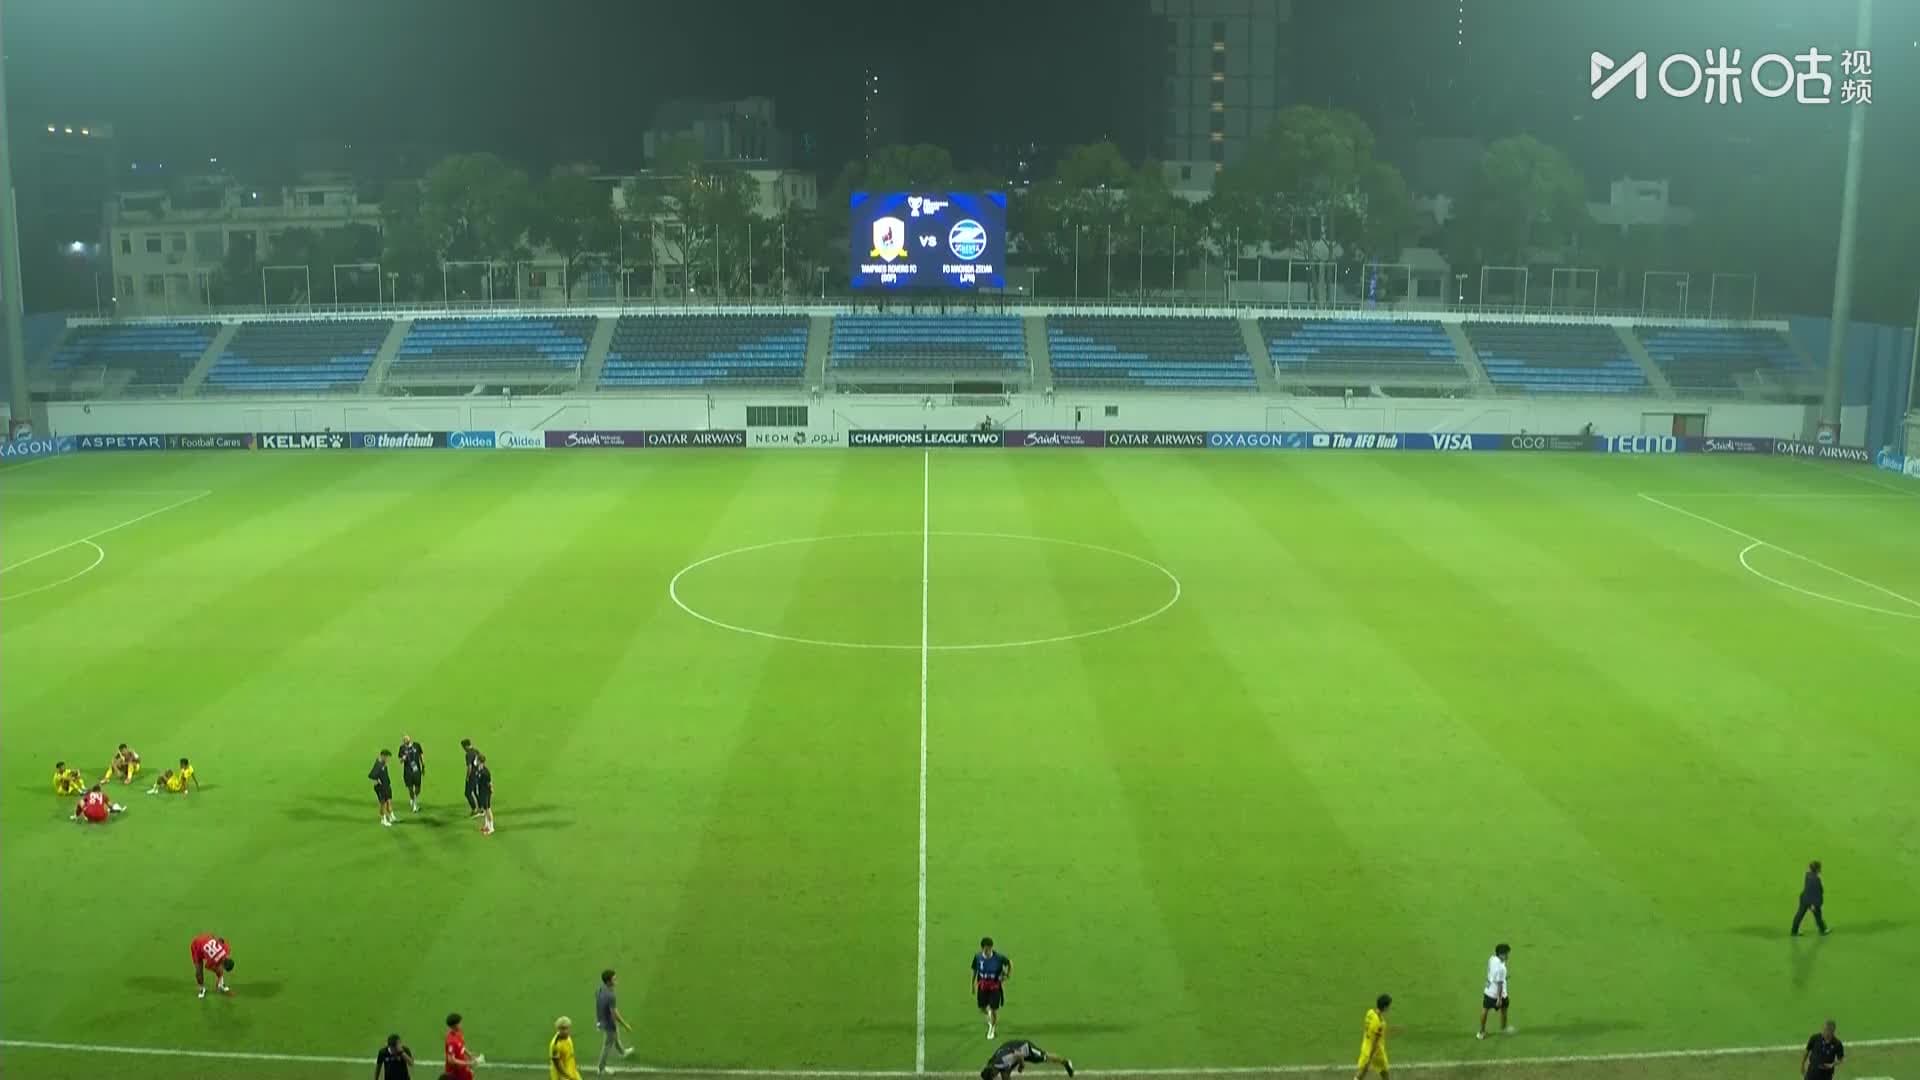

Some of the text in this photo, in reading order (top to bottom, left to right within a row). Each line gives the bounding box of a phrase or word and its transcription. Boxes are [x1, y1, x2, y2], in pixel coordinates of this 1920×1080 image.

[919, 235, 937, 247] VS
[81, 436, 161, 448] ASPETAR
[181, 437, 241, 447] Football Cares
[263, 434, 328, 449] KELME
[456, 433, 492, 448] Midea
[506, 433, 542, 447] Midea
[565, 432, 600, 447] Saudi
[649, 434, 743, 445] QATAR AIRWAYS
[756, 434, 789, 443] NEOM
[855, 433, 998, 444] CHAMPIONS LEAGUE TWO
[1024, 432, 1060, 446] Saudi
[1109, 434, 1203, 445] QATAR AIRWAYS
[1211, 434, 1282, 447] OXAGON
[1333, 434, 1352, 448] The
[1376, 434, 1398, 448] Hub
[1431, 434, 1473, 450] VISA
[1511, 436, 1545, 448] ace
[1603, 435, 1677, 453] TECNO
[1777, 442, 1869, 461] QATAR AIRWAYS
[203, 939, 223, 958] 82
